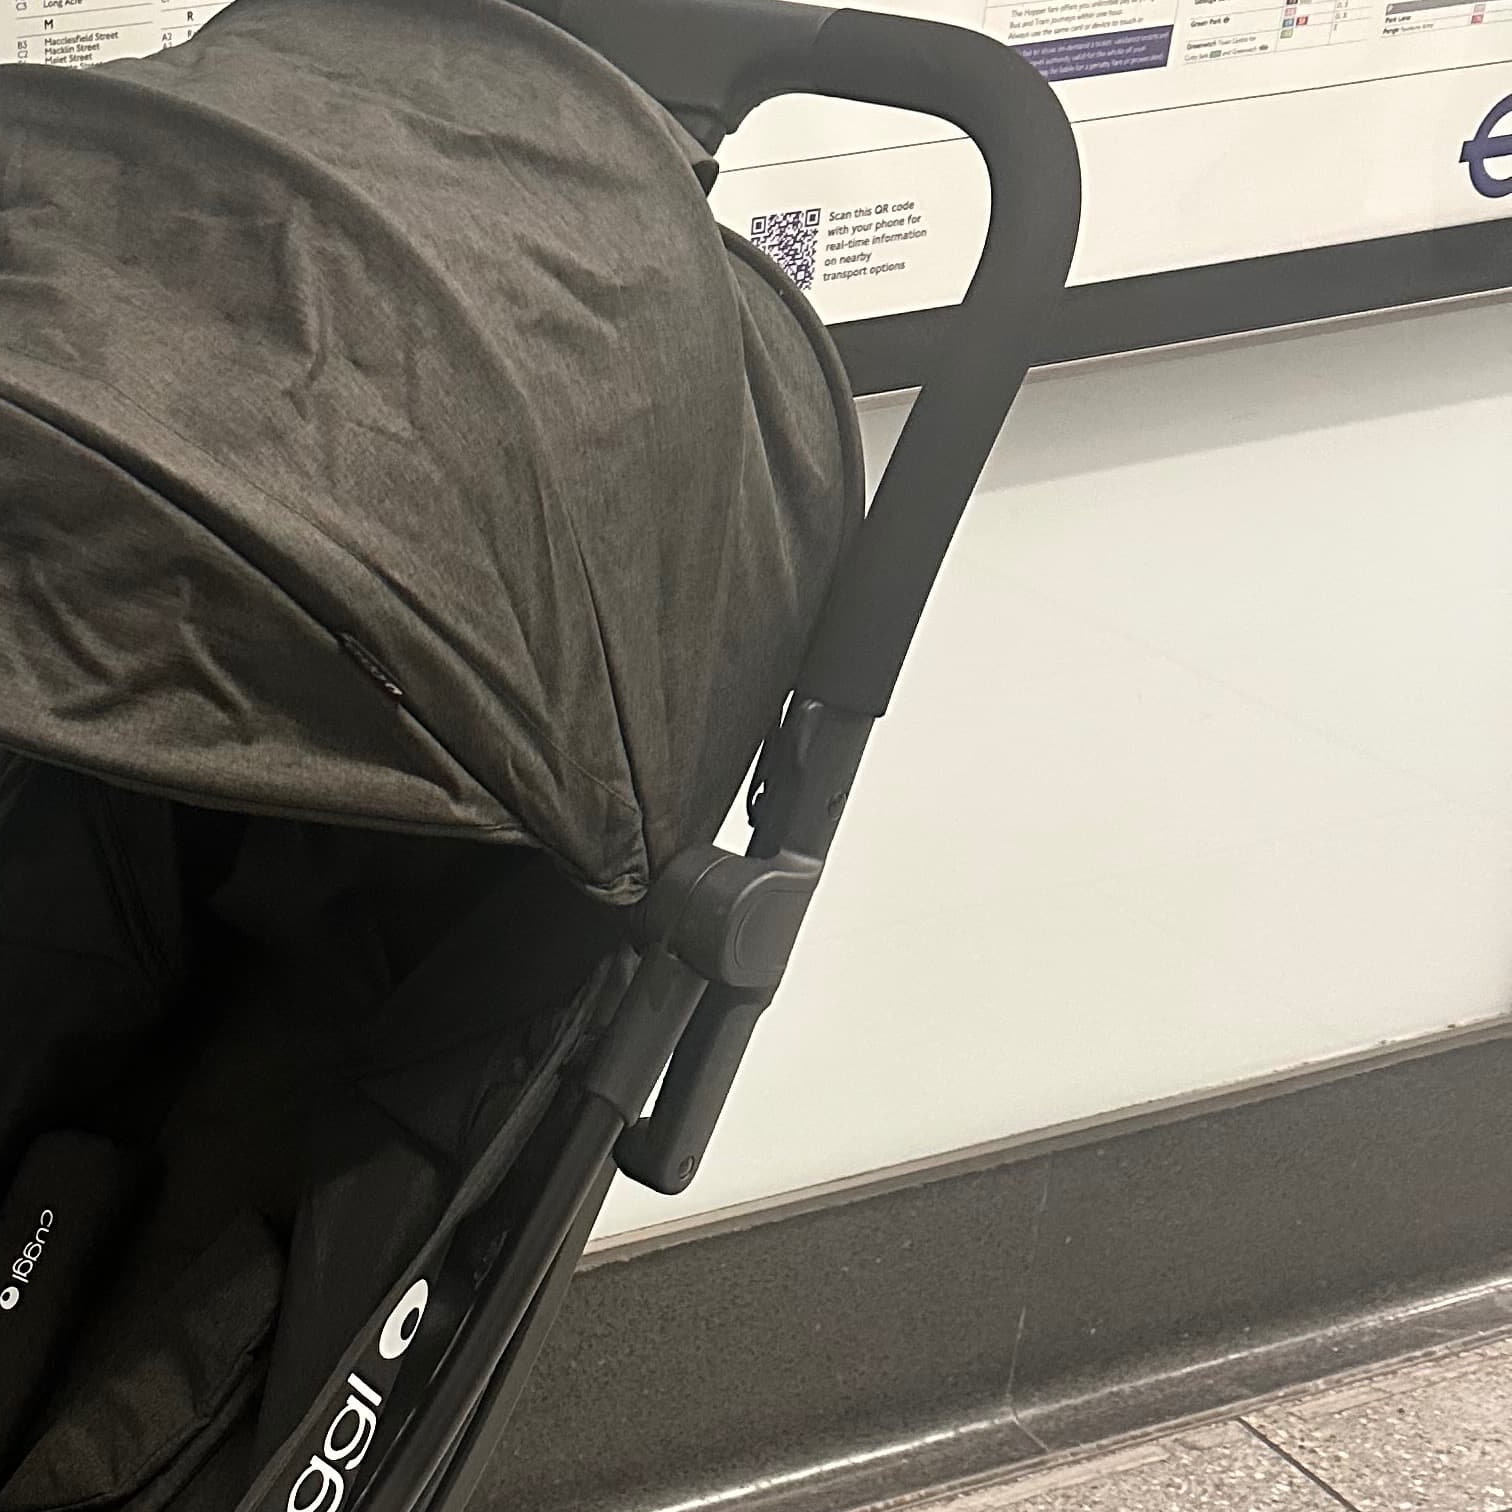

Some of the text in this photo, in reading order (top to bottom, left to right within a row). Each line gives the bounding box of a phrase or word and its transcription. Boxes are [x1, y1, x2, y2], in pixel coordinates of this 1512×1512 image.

[188, 11, 194, 22] R
[44, 19, 54, 30] M
[44, 33, 94, 46] Macclesfield
[94, 32, 118, 40] Street
[45, 46, 74, 56] Macklin
[76, 43, 100, 52] Street
[69, 54, 92, 62] Street
[829, 200, 914, 222] Scan this QR code
[828, 214, 922, 236] with your phone for
[826, 229, 927, 251] real-time information
[824, 252, 872, 266] on nearby
[823, 262, 905, 281] transport options
